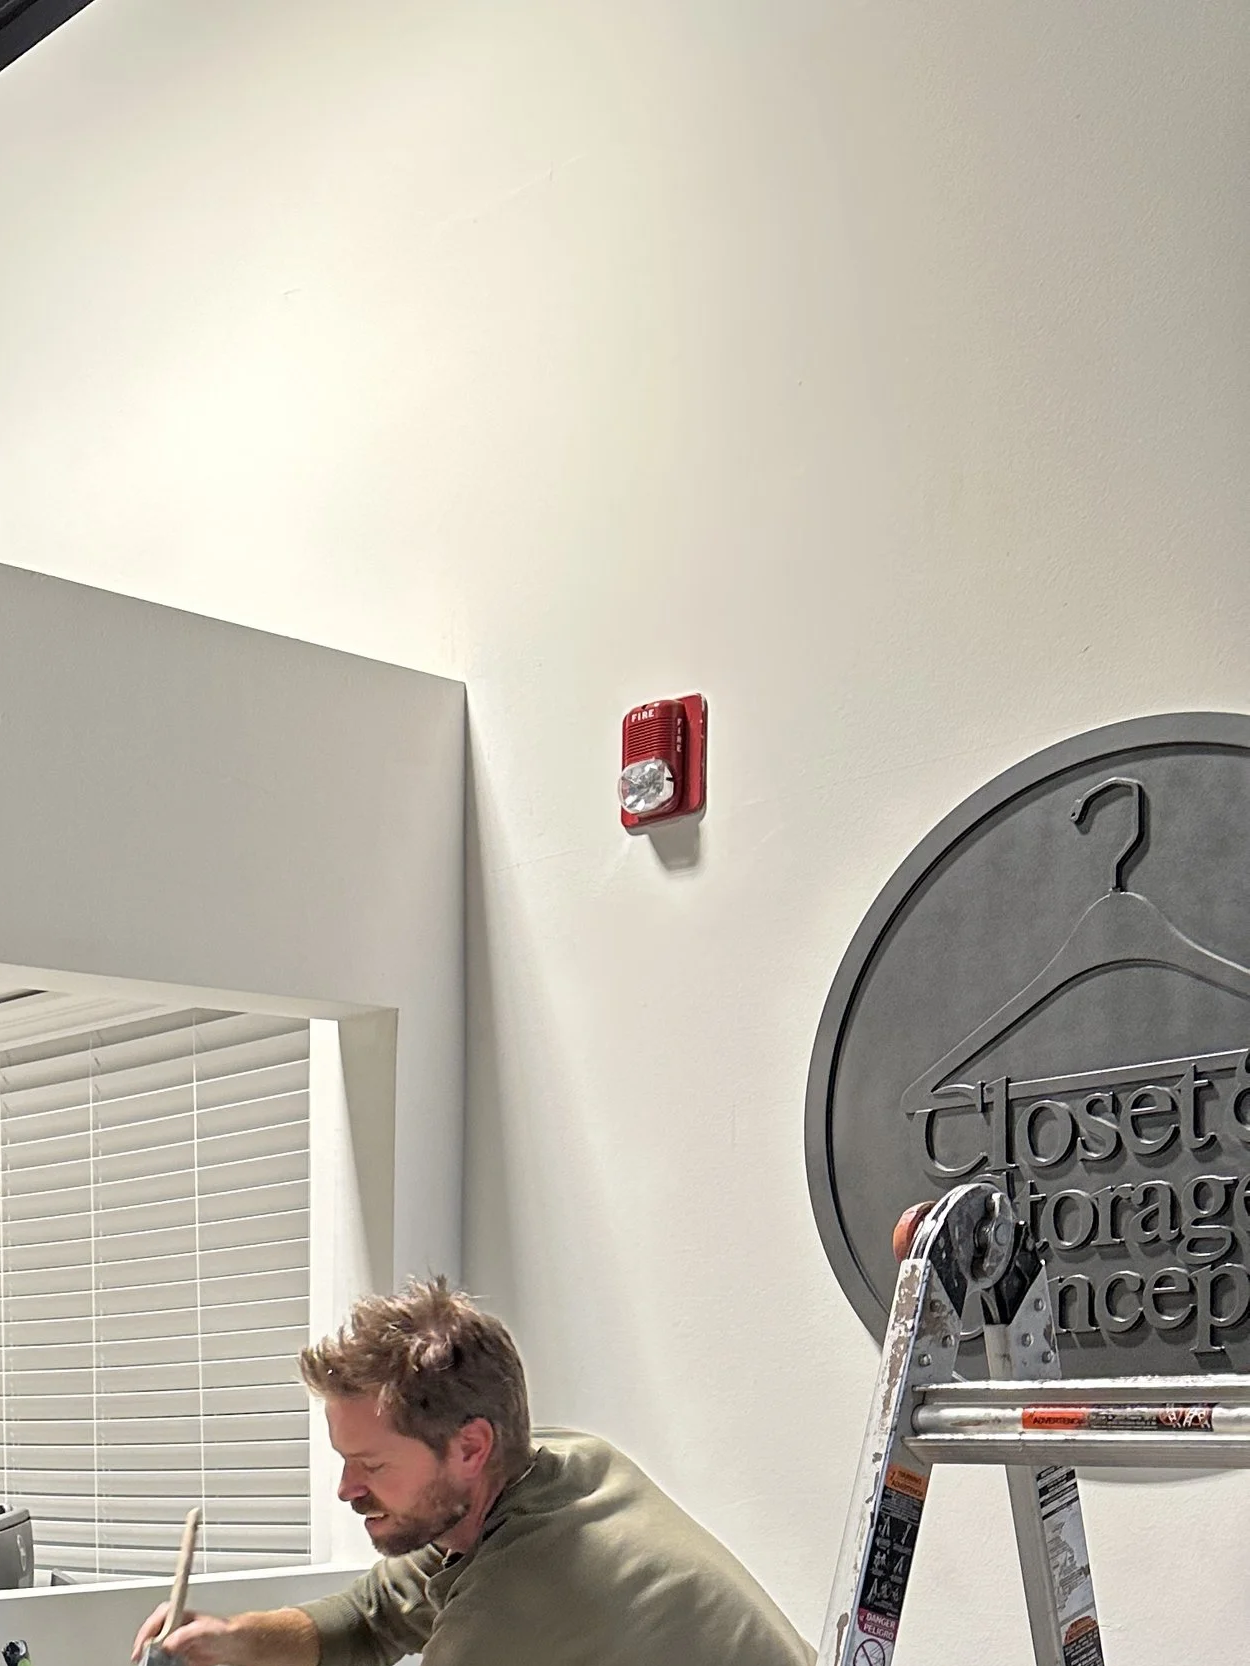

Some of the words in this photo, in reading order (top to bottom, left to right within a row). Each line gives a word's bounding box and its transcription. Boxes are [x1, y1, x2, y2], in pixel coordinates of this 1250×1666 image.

[631, 709, 655, 723] FIRE
[675, 718, 683, 752] FIRE
[913, 1063, 1218, 1178] Closet
[966, 1172, 1250, 1266] torag
[863, 1623, 894, 1641] PELIGRO
[866, 1612, 896, 1630] DANGER
